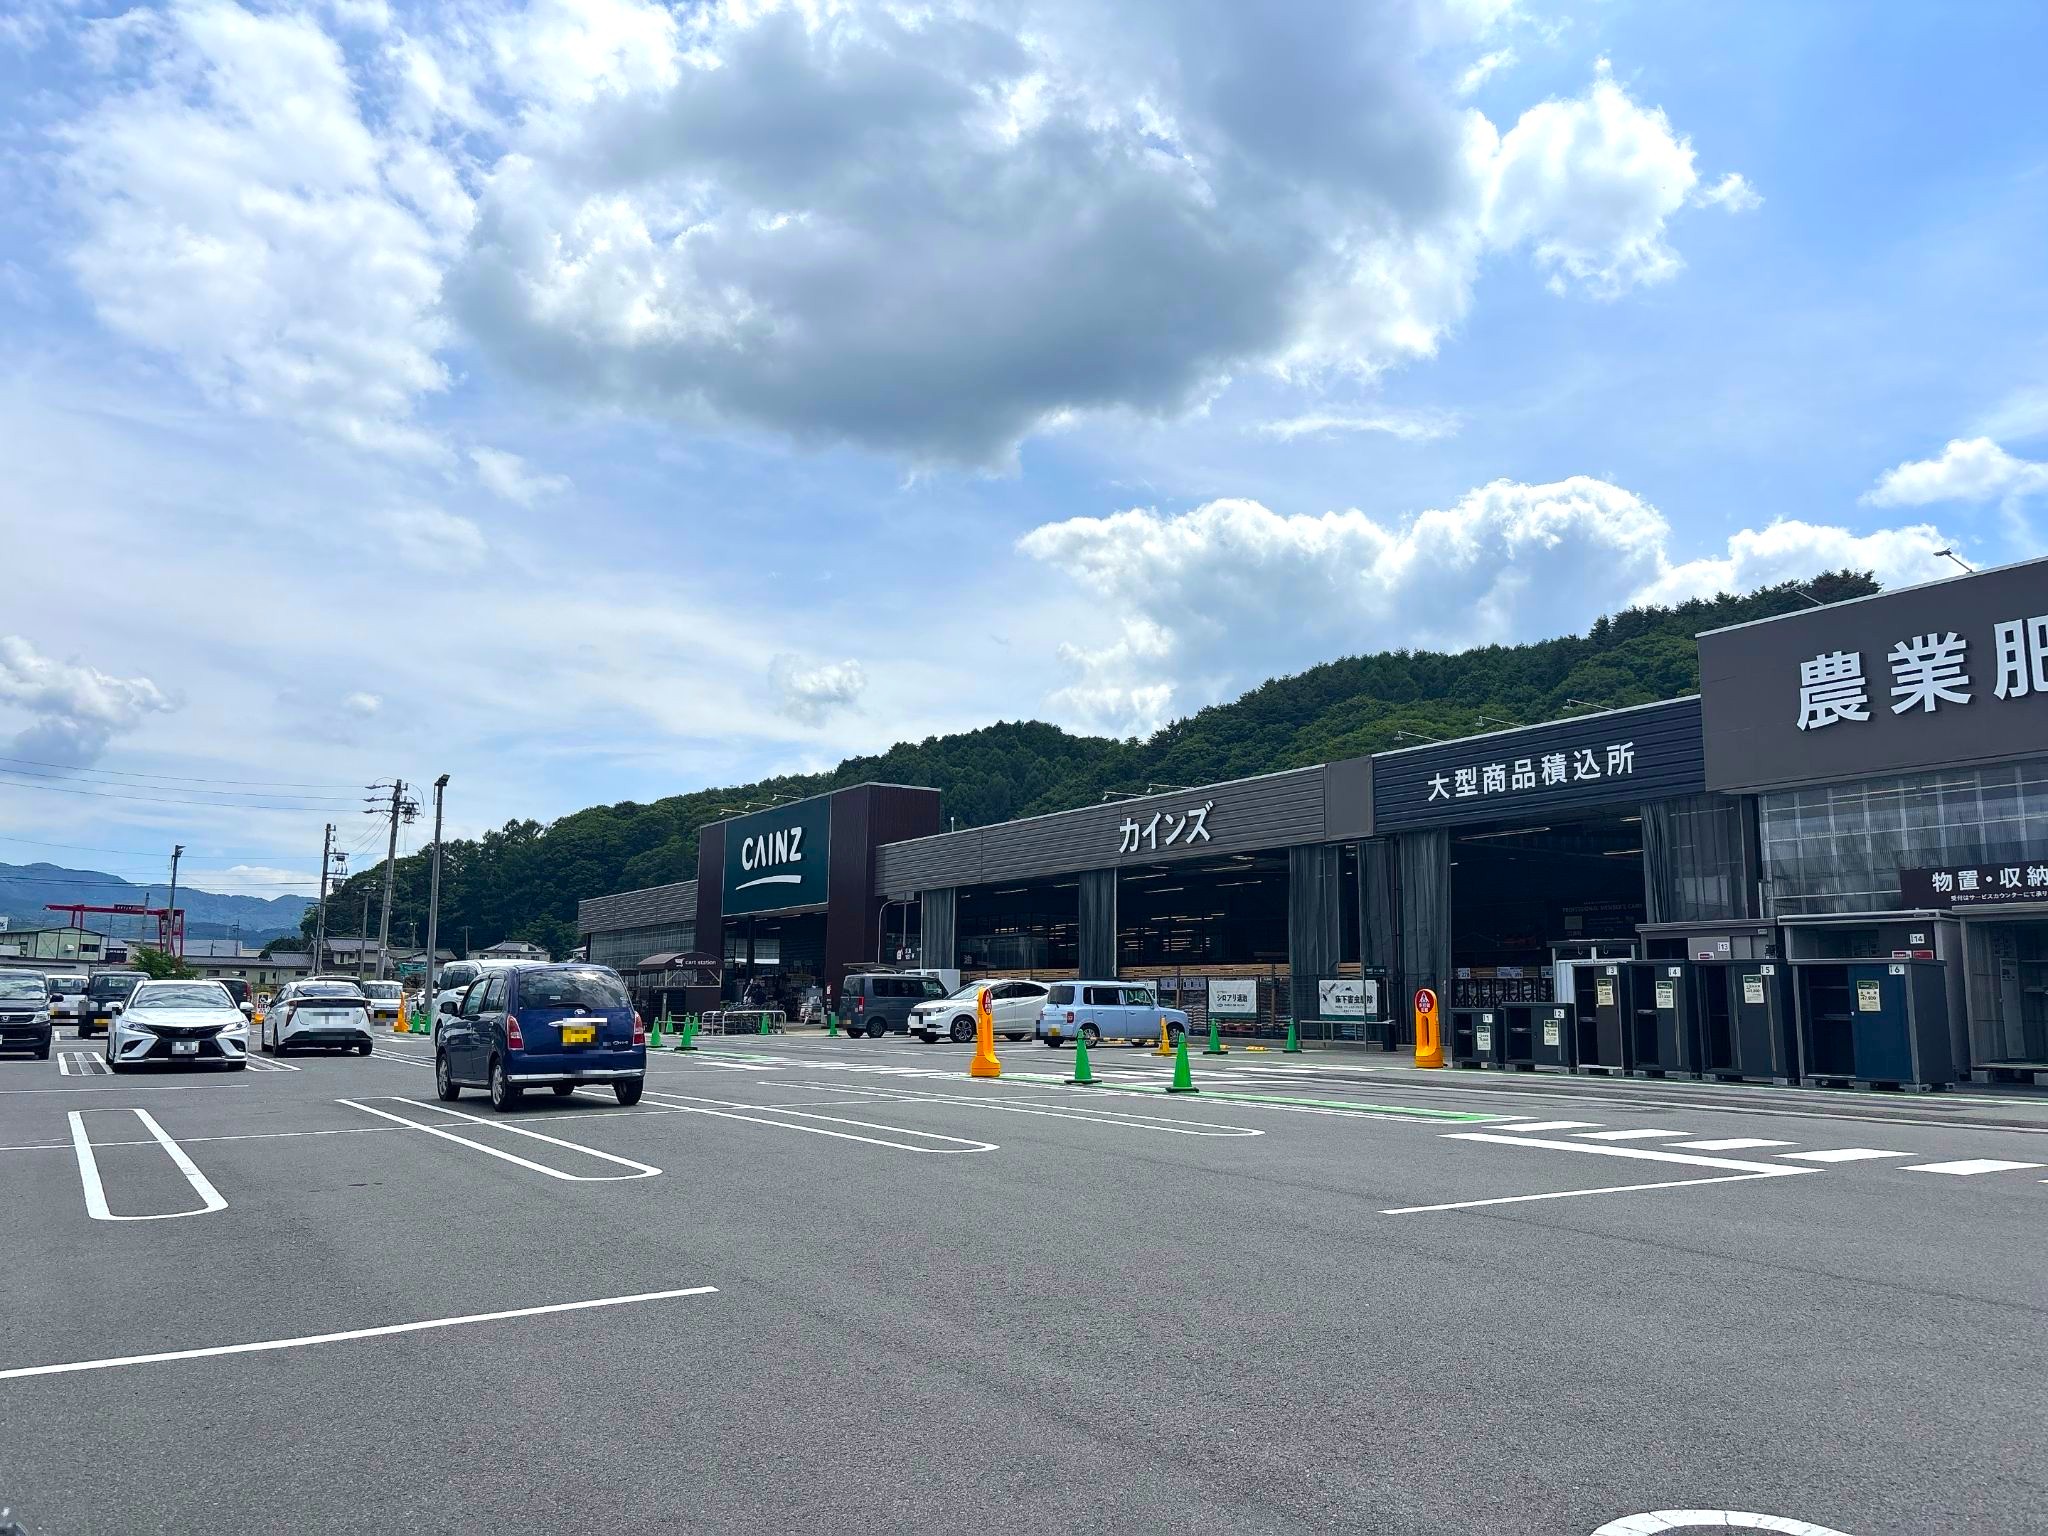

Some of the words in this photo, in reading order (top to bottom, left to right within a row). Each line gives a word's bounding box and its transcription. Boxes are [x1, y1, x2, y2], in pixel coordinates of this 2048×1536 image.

[1427, 741, 1635, 802] 大型商品積込所
[741, 826, 802, 871] CAINZ
[1119, 800, 1214, 853] カインズ
[1932, 865, 2048, 892] 物置・収納
